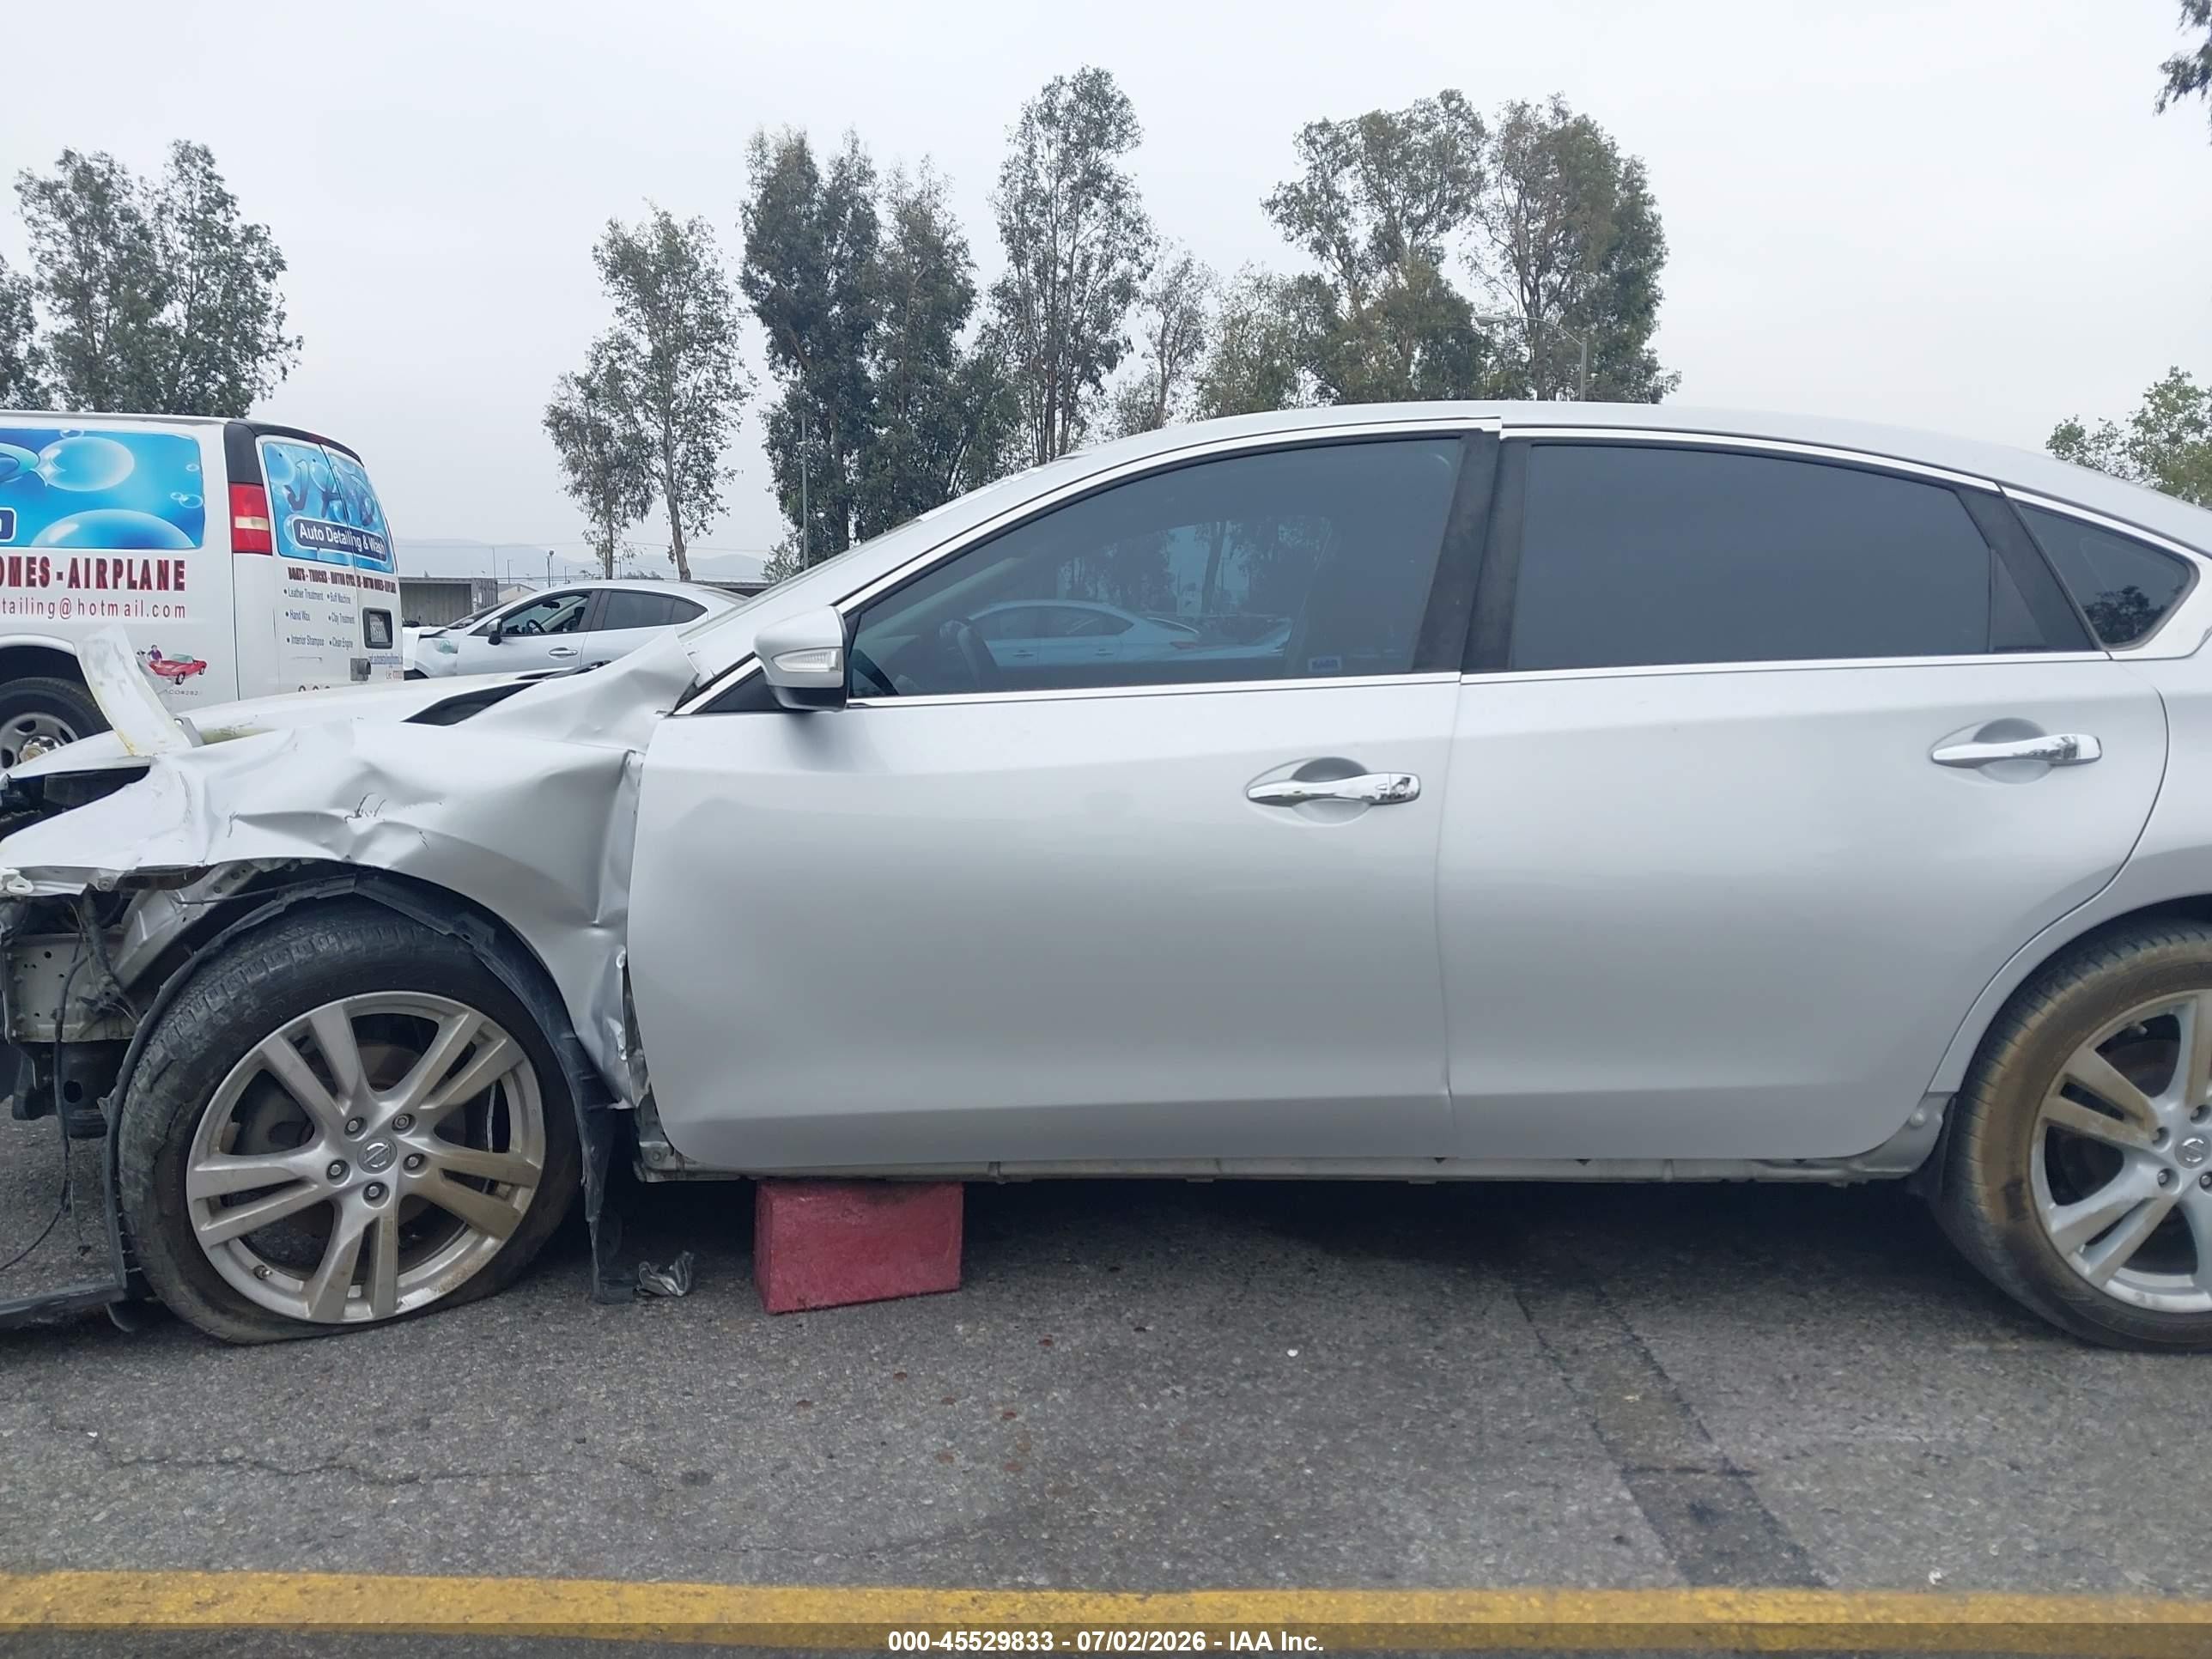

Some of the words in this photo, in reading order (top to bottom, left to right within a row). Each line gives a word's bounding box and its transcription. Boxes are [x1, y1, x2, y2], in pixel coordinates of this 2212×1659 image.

[300, 521, 325, 541] Auto
[325, 526, 362, 552] Detailing
[362, 534, 368, 550] &
[368, 536, 386, 555] Wash
[3, 598, 185, 620] tailing@hotmail.com
